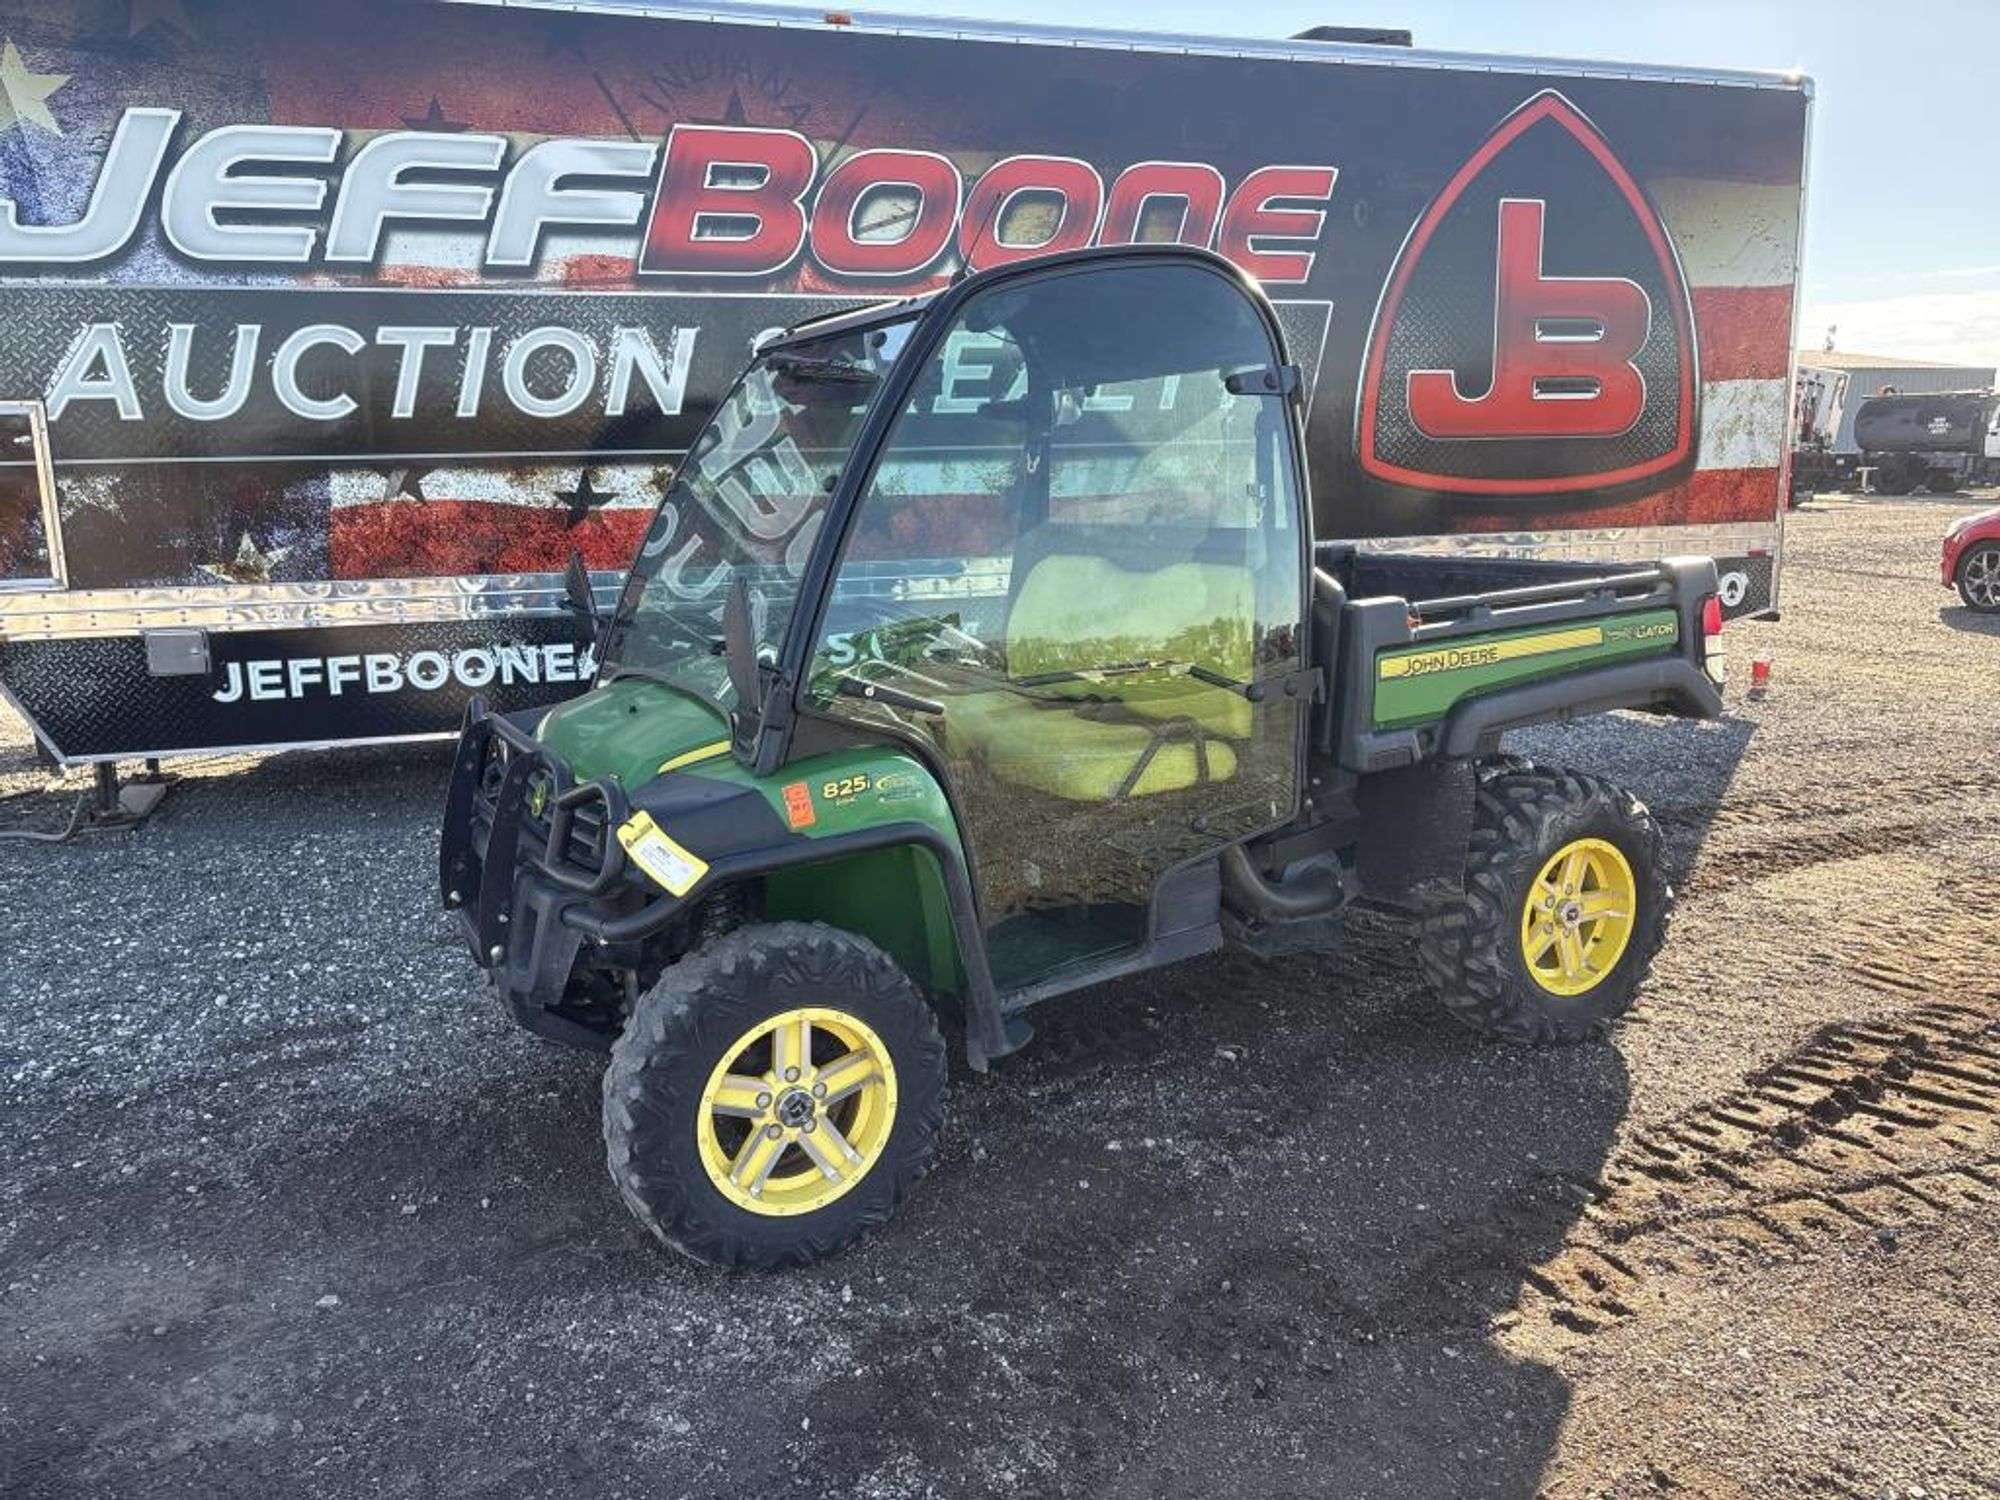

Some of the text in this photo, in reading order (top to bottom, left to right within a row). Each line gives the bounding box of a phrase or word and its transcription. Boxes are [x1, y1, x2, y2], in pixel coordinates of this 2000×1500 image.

[1408, 199, 1651, 438] JB
[45, 323, 700, 420] AUCTION
[1403, 646, 1499, 675] JOHN DEERE
